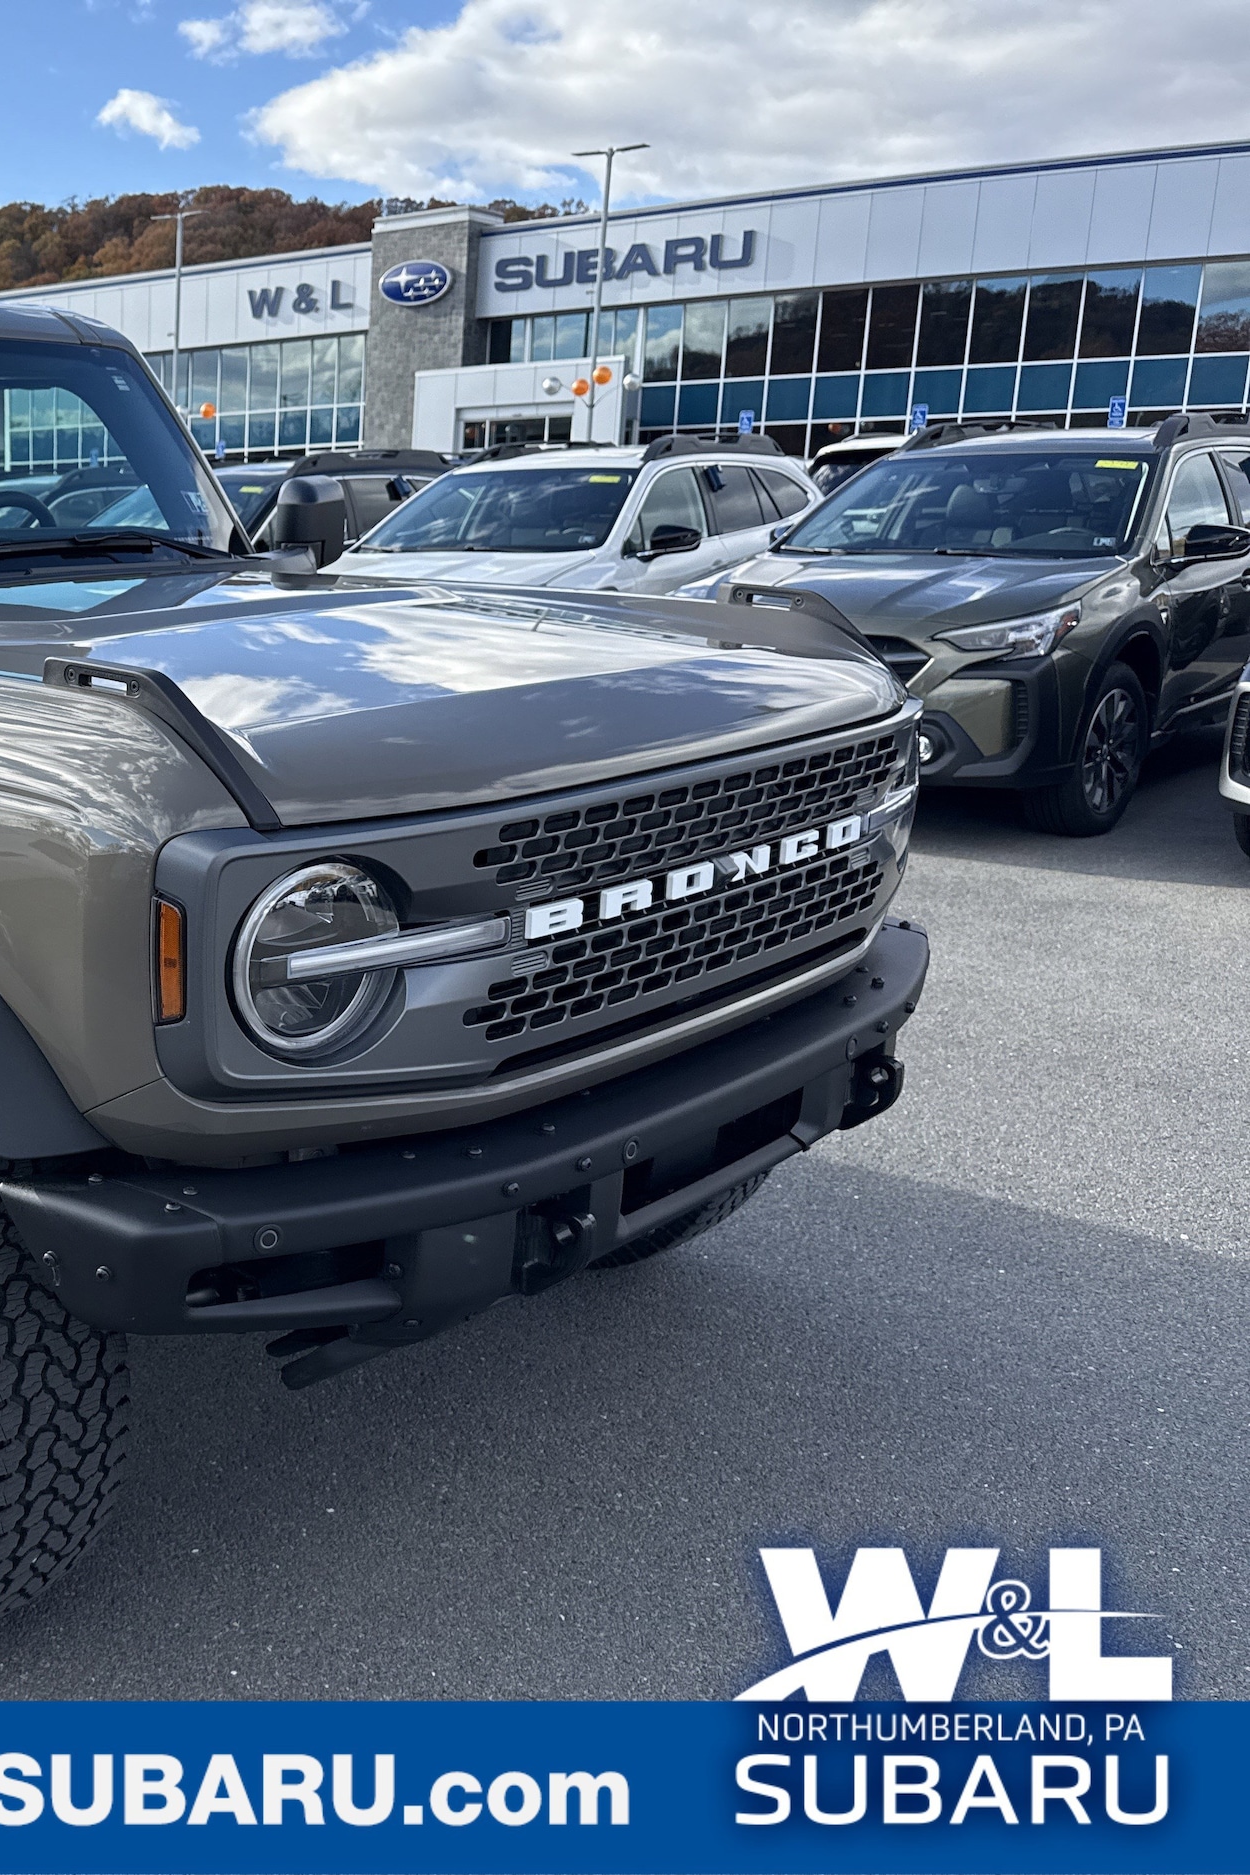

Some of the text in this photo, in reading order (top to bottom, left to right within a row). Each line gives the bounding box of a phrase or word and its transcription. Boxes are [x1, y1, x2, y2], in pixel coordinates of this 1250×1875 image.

[493, 229, 756, 293] SUBARU
[247, 279, 354, 319] W & L
[524, 815, 862, 940] BRONCO
